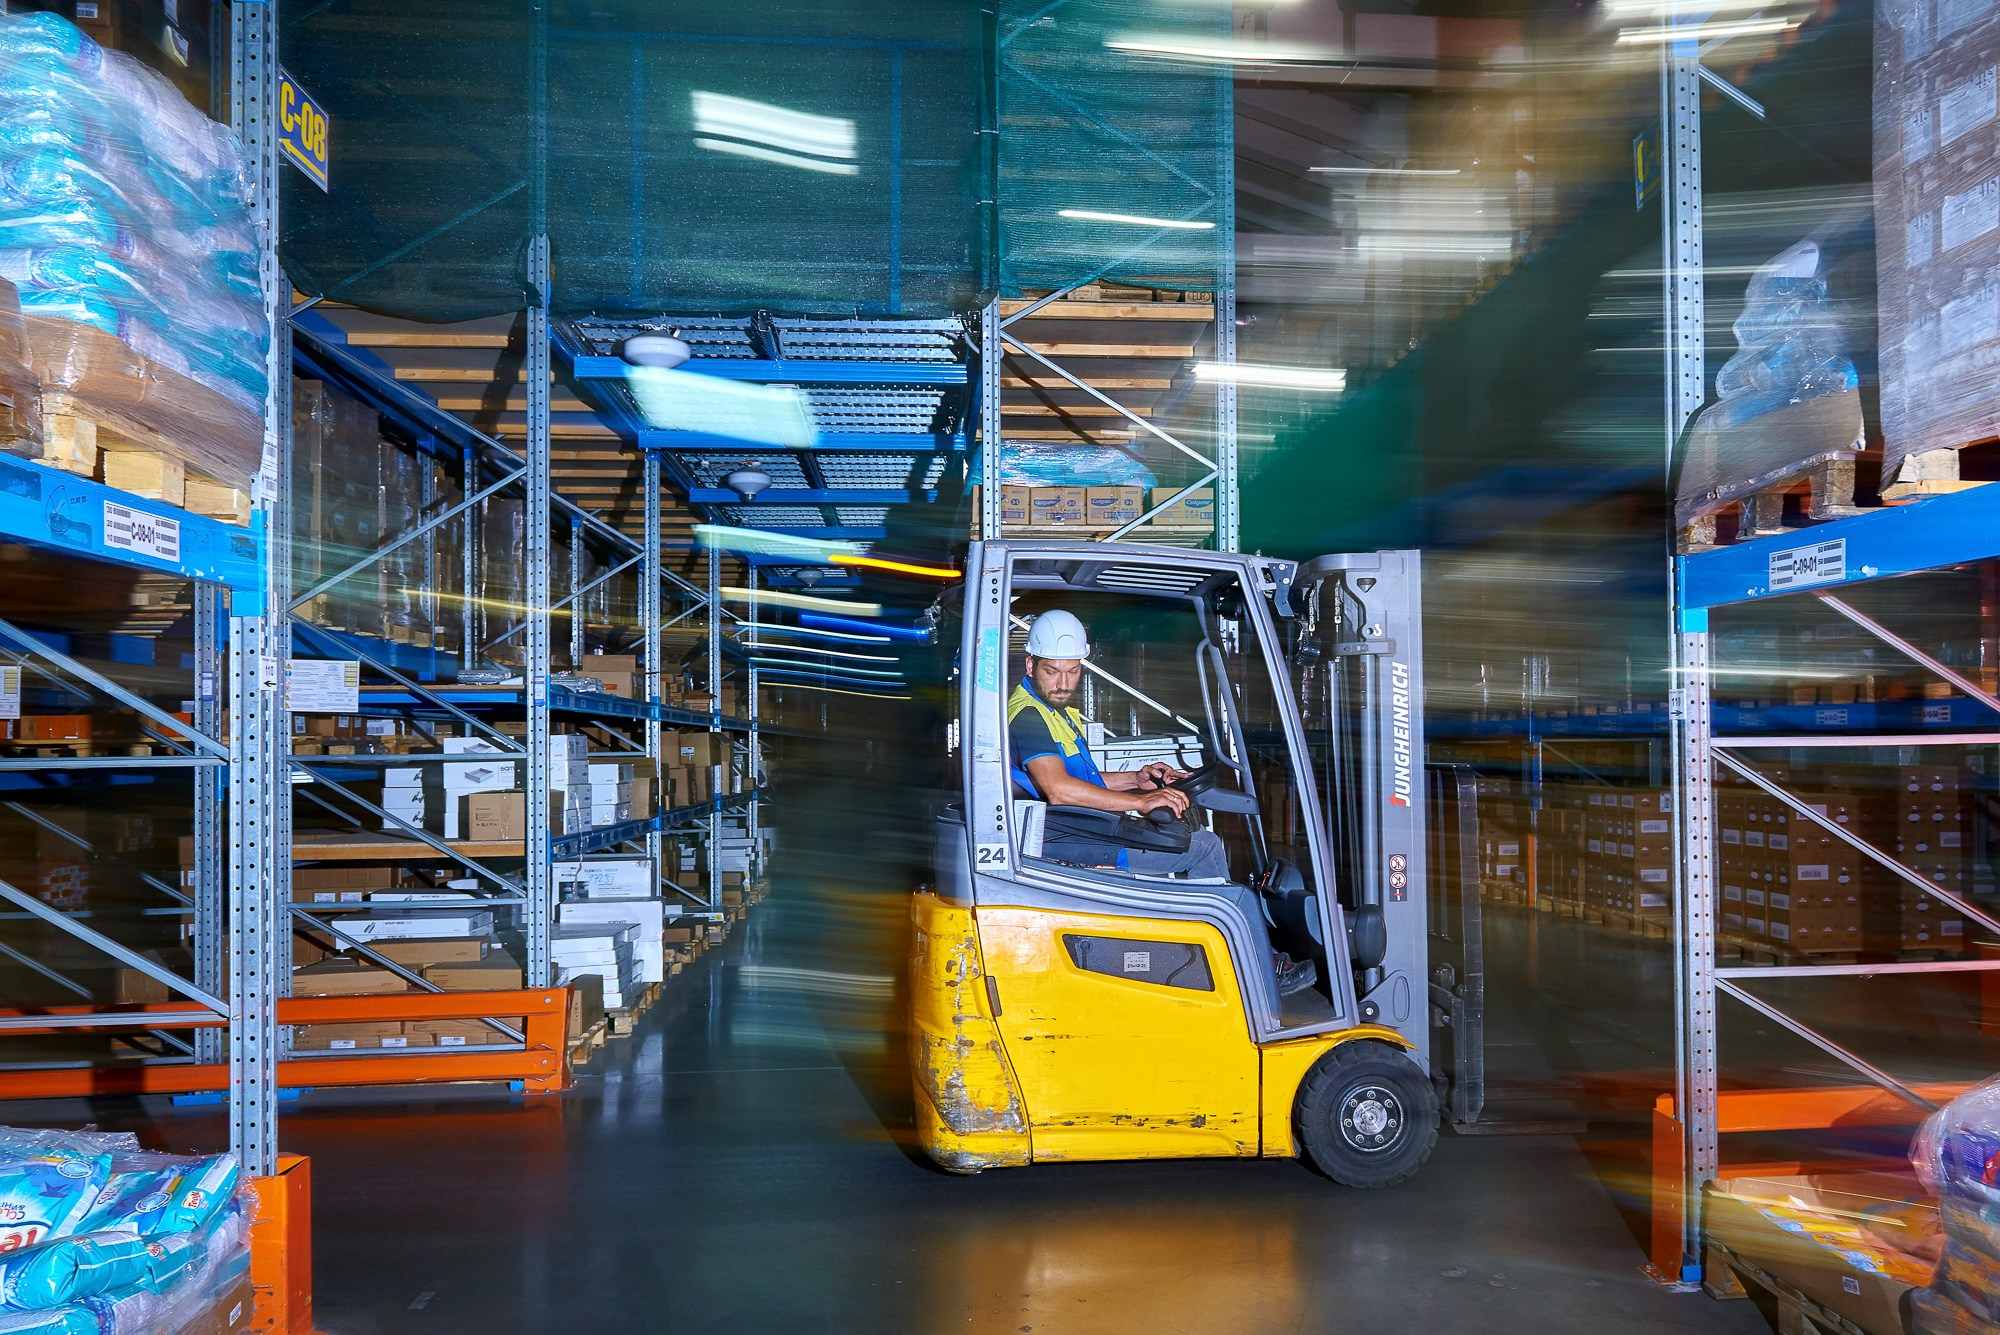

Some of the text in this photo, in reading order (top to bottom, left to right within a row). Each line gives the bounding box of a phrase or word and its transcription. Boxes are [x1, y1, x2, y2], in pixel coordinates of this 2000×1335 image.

[281, 81, 326, 163] C-08
[131, 521, 155, 545] C-08-01
[1793, 555, 1817, 576] C-09-01
[985, 645, 995, 685] EFG 215
[1389, 661, 1411, 808] JUNGHEINRICH
[978, 847, 1006, 864] 24
